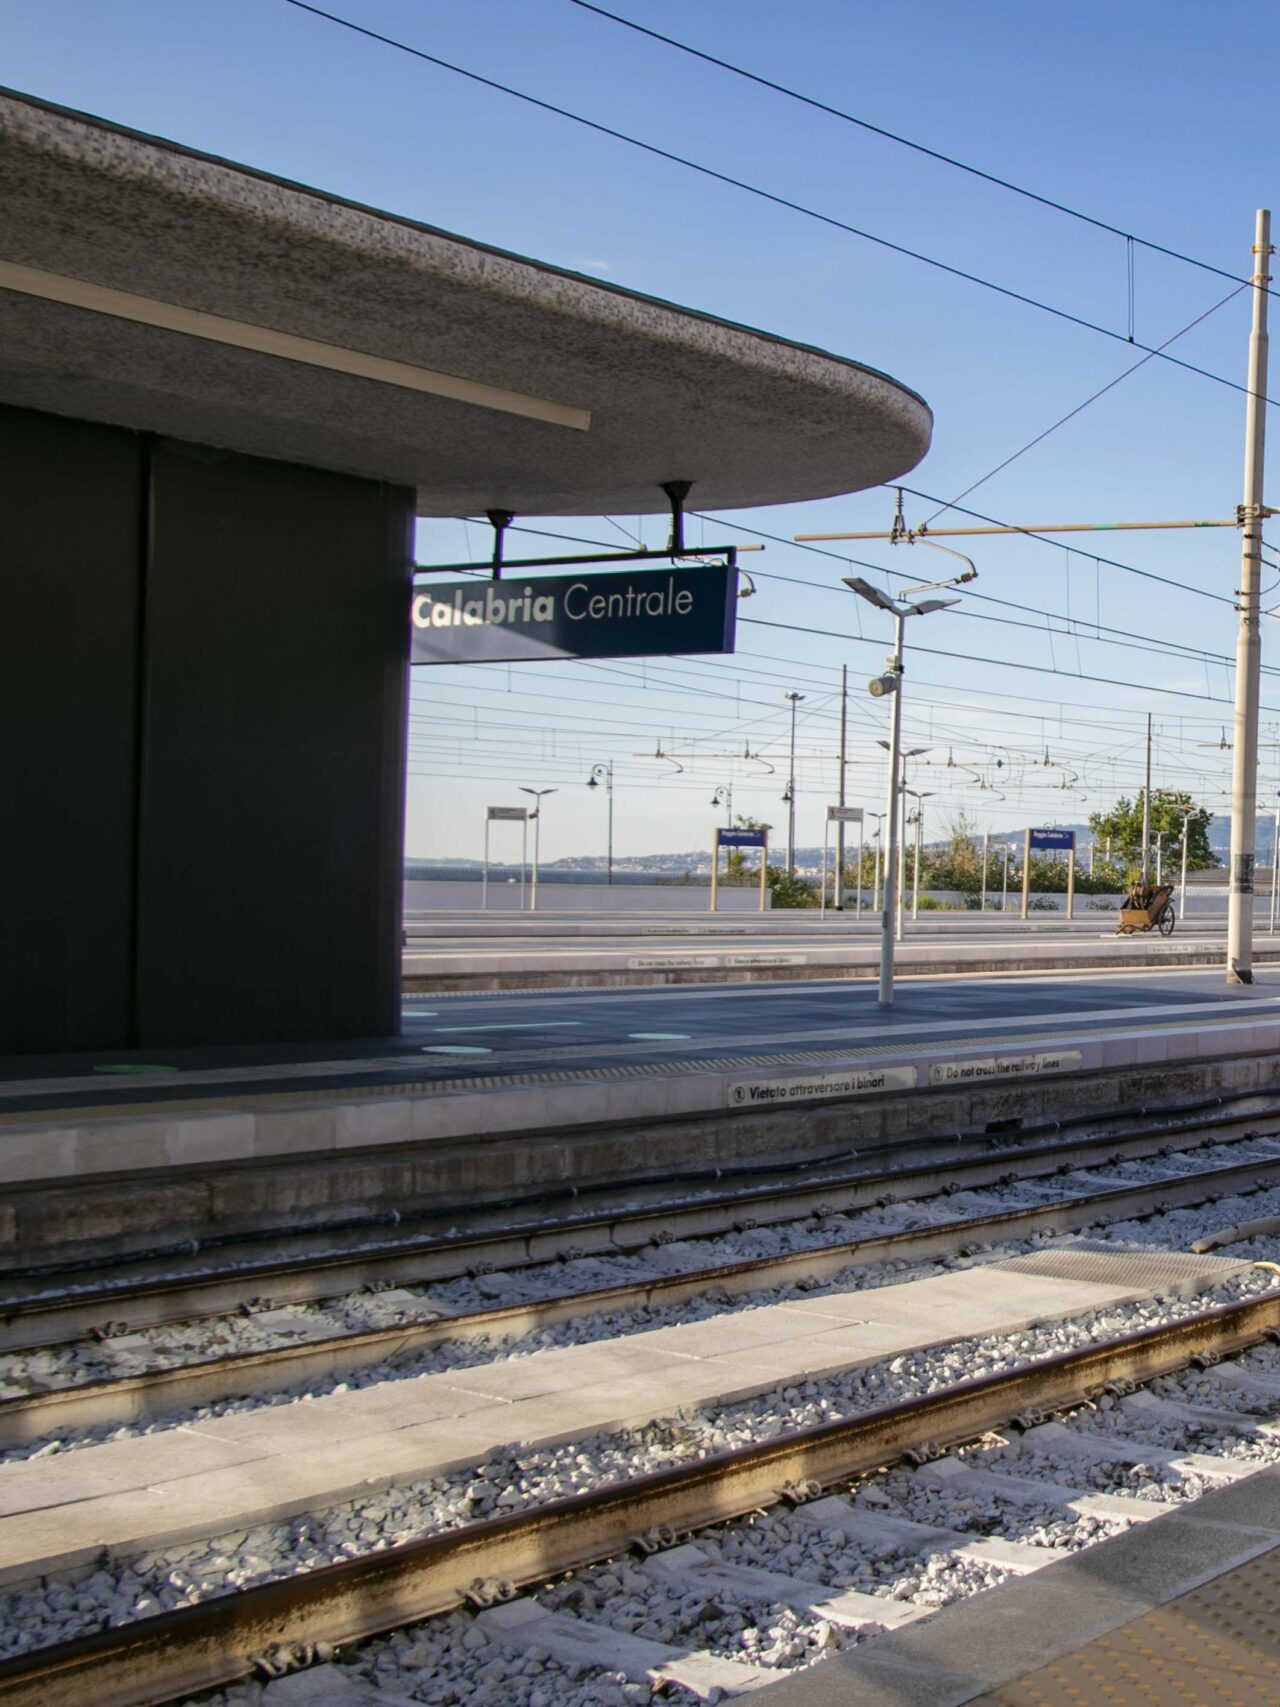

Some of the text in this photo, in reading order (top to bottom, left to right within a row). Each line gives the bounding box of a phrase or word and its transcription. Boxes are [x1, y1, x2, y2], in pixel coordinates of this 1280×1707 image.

[411, 577, 694, 628] Calabria Centrale
[947, 1057, 1060, 1079] Do not cross the railway lines
[749, 1087, 787, 1100] Vietato
[789, 1081, 850, 1096] attraversare
[857, 1075, 886, 1090] binari
